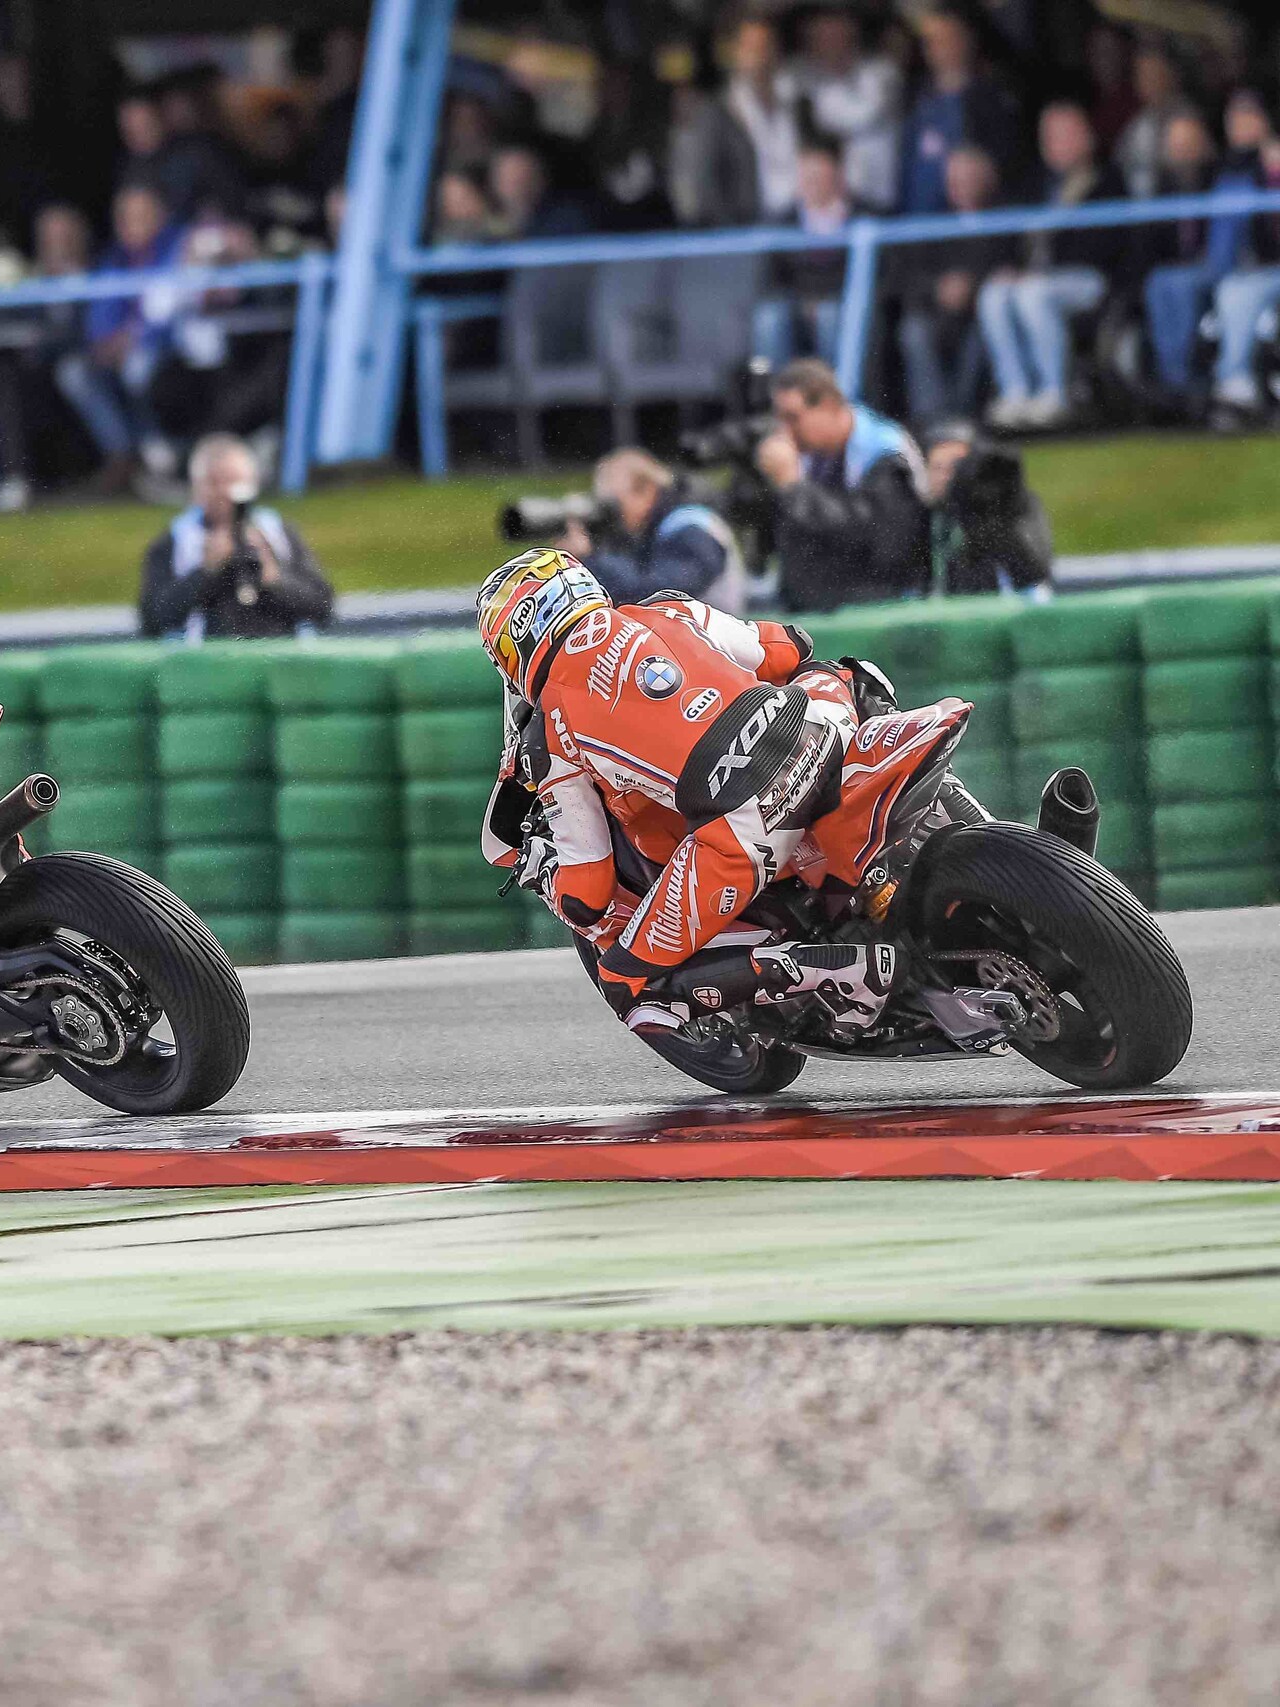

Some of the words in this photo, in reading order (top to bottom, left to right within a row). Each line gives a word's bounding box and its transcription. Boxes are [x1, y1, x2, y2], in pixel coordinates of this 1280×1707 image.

[511, 600, 533, 640] Arai
[686, 688, 717, 719] Gulf
[708, 690, 789, 799] IXON
[719, 887, 737, 915] Gulf
